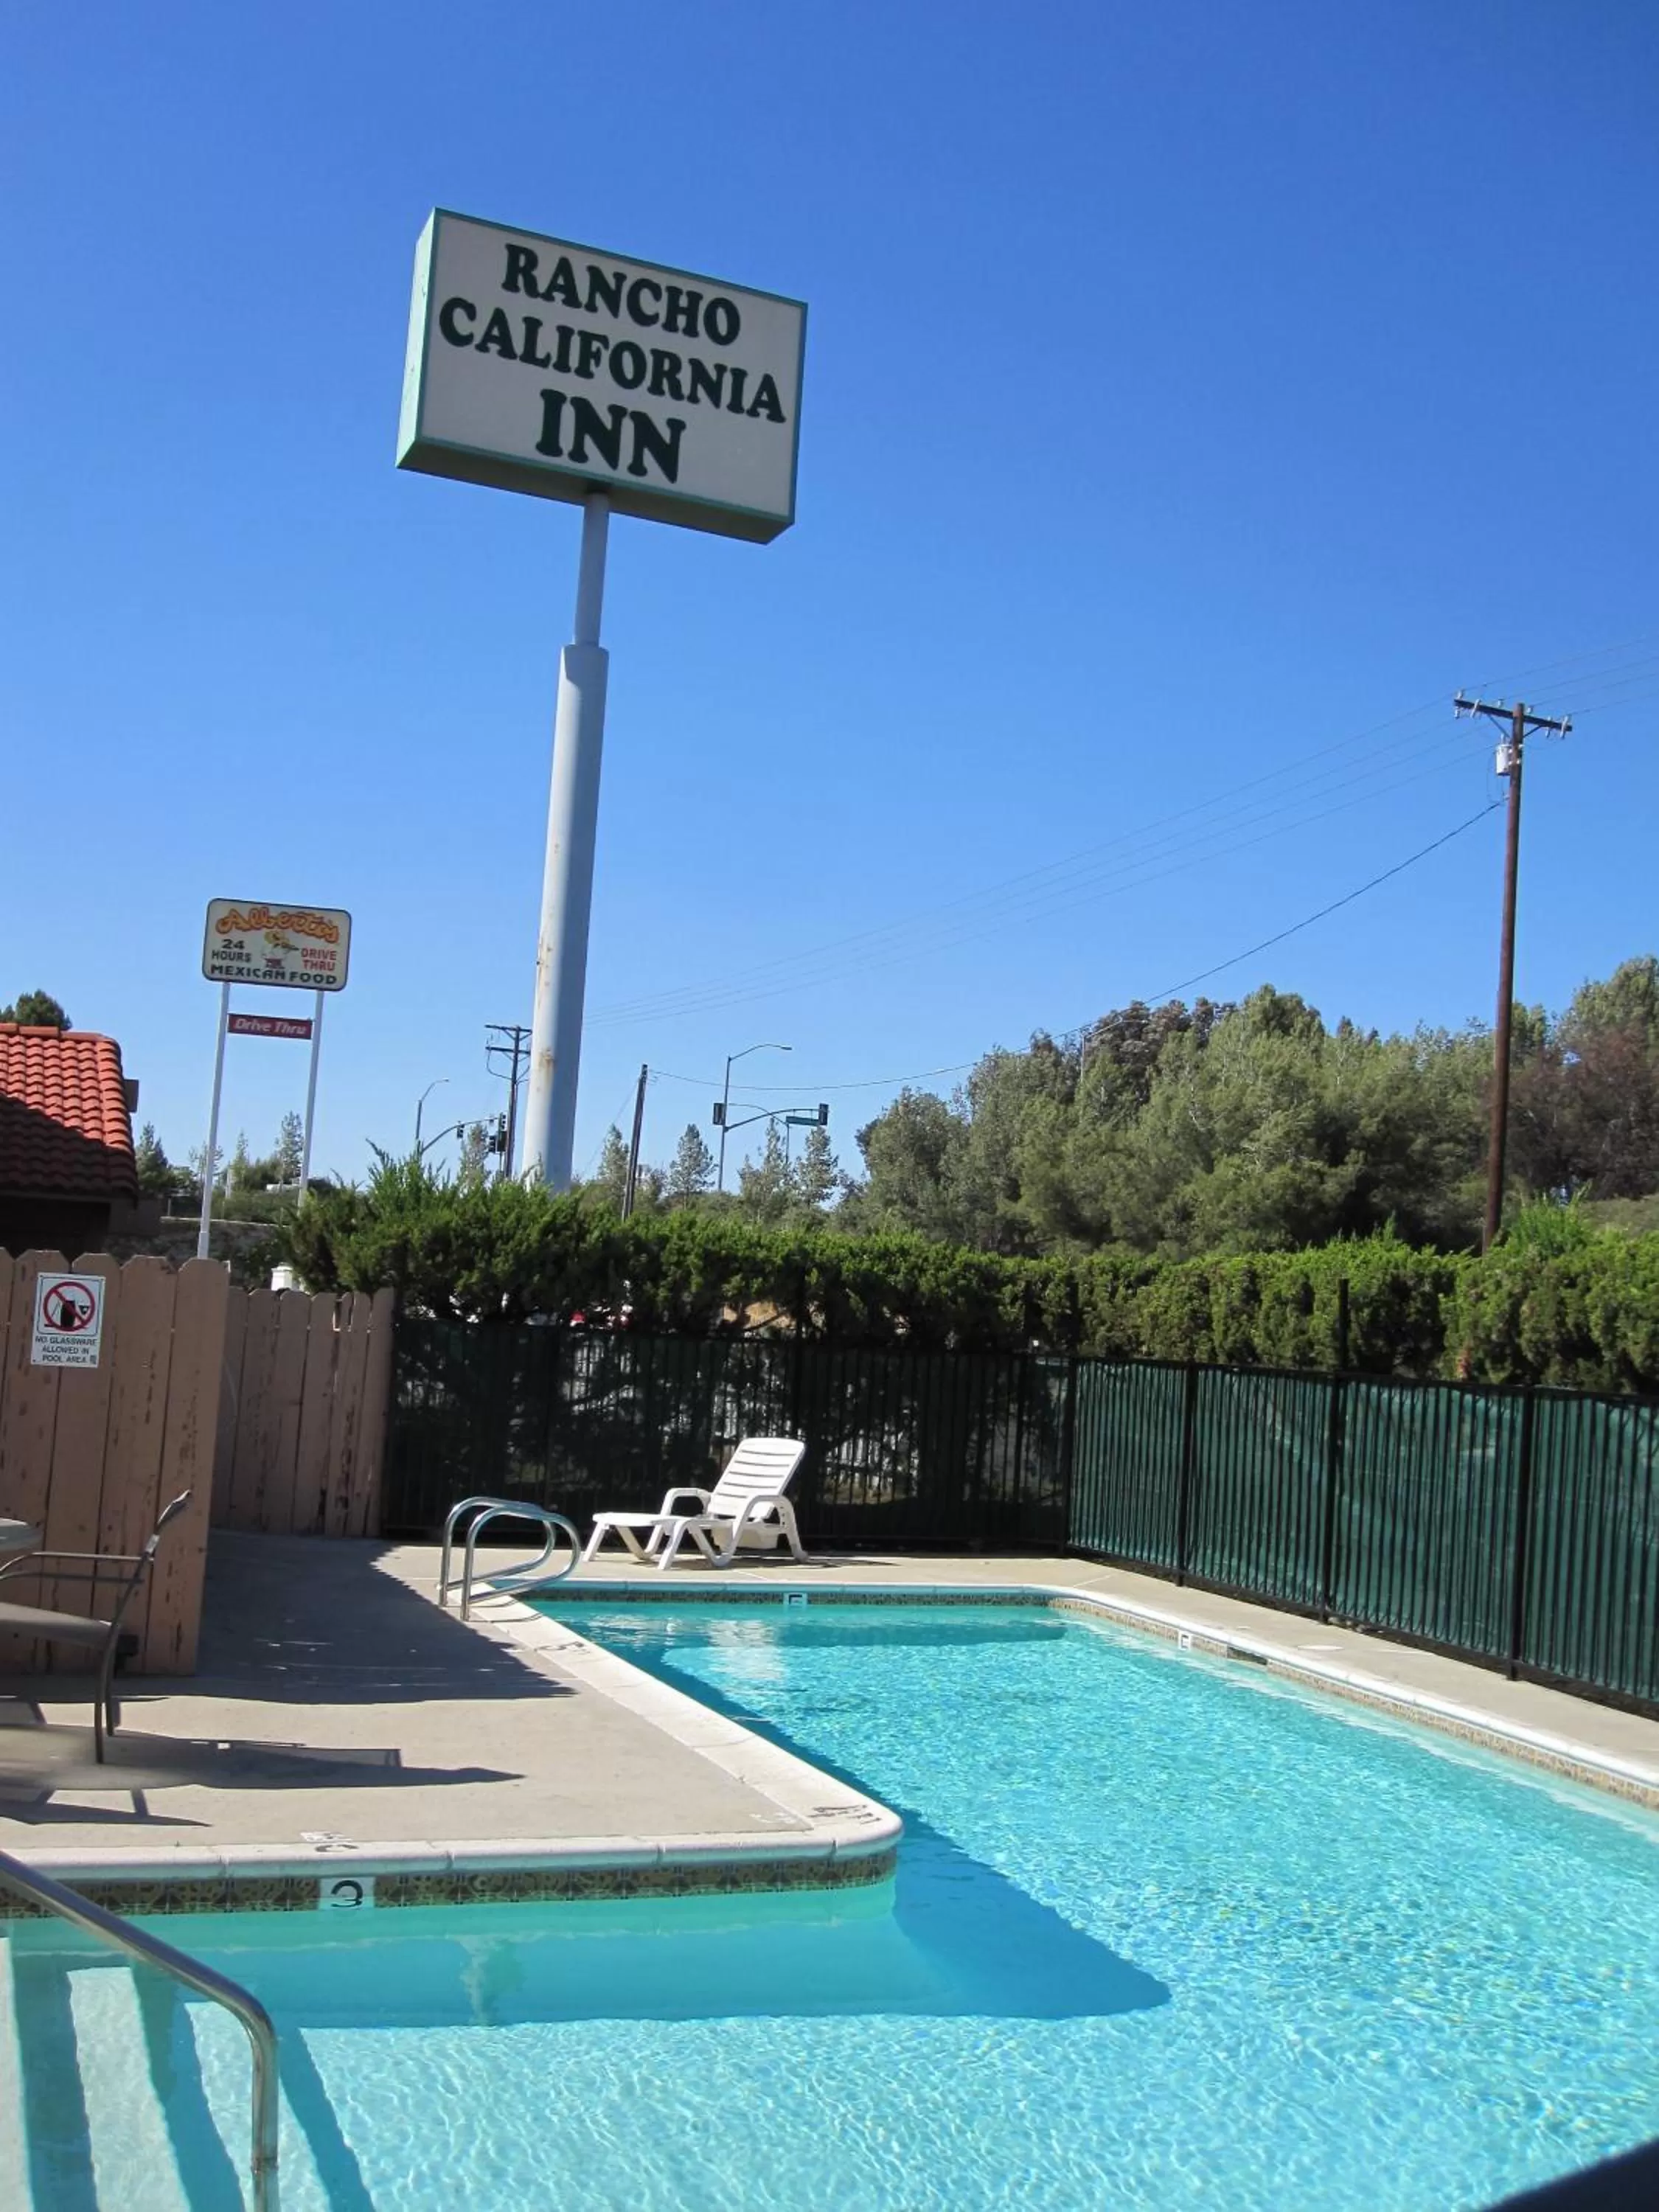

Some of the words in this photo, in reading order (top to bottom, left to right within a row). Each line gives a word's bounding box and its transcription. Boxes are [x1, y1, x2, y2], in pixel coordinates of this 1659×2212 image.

[501, 243, 741, 345] RANCHO
[439, 296, 787, 423] CALIFORNIA
[535, 389, 686, 484] INN
[222, 939, 245, 950] 24
[211, 950, 252, 963] HOURS
[301, 948, 337, 961] DRIVE
[303, 960, 335, 972] THRU
[210, 964, 285, 980] MEXICAN
[288, 971, 337, 985] FOOD
[234, 1018, 272, 1032] Drive
[275, 1020, 307, 1034] Thru
[35, 1335, 46, 1344] NO
[49, 1336, 97, 1346] GLASSWARE
[42, 1345, 78, 1354] ALLOWED
[81, 1346, 89, 1355] IN
[42, 1354, 63, 1363] POOL
[66, 1355, 87, 1363] AREA
